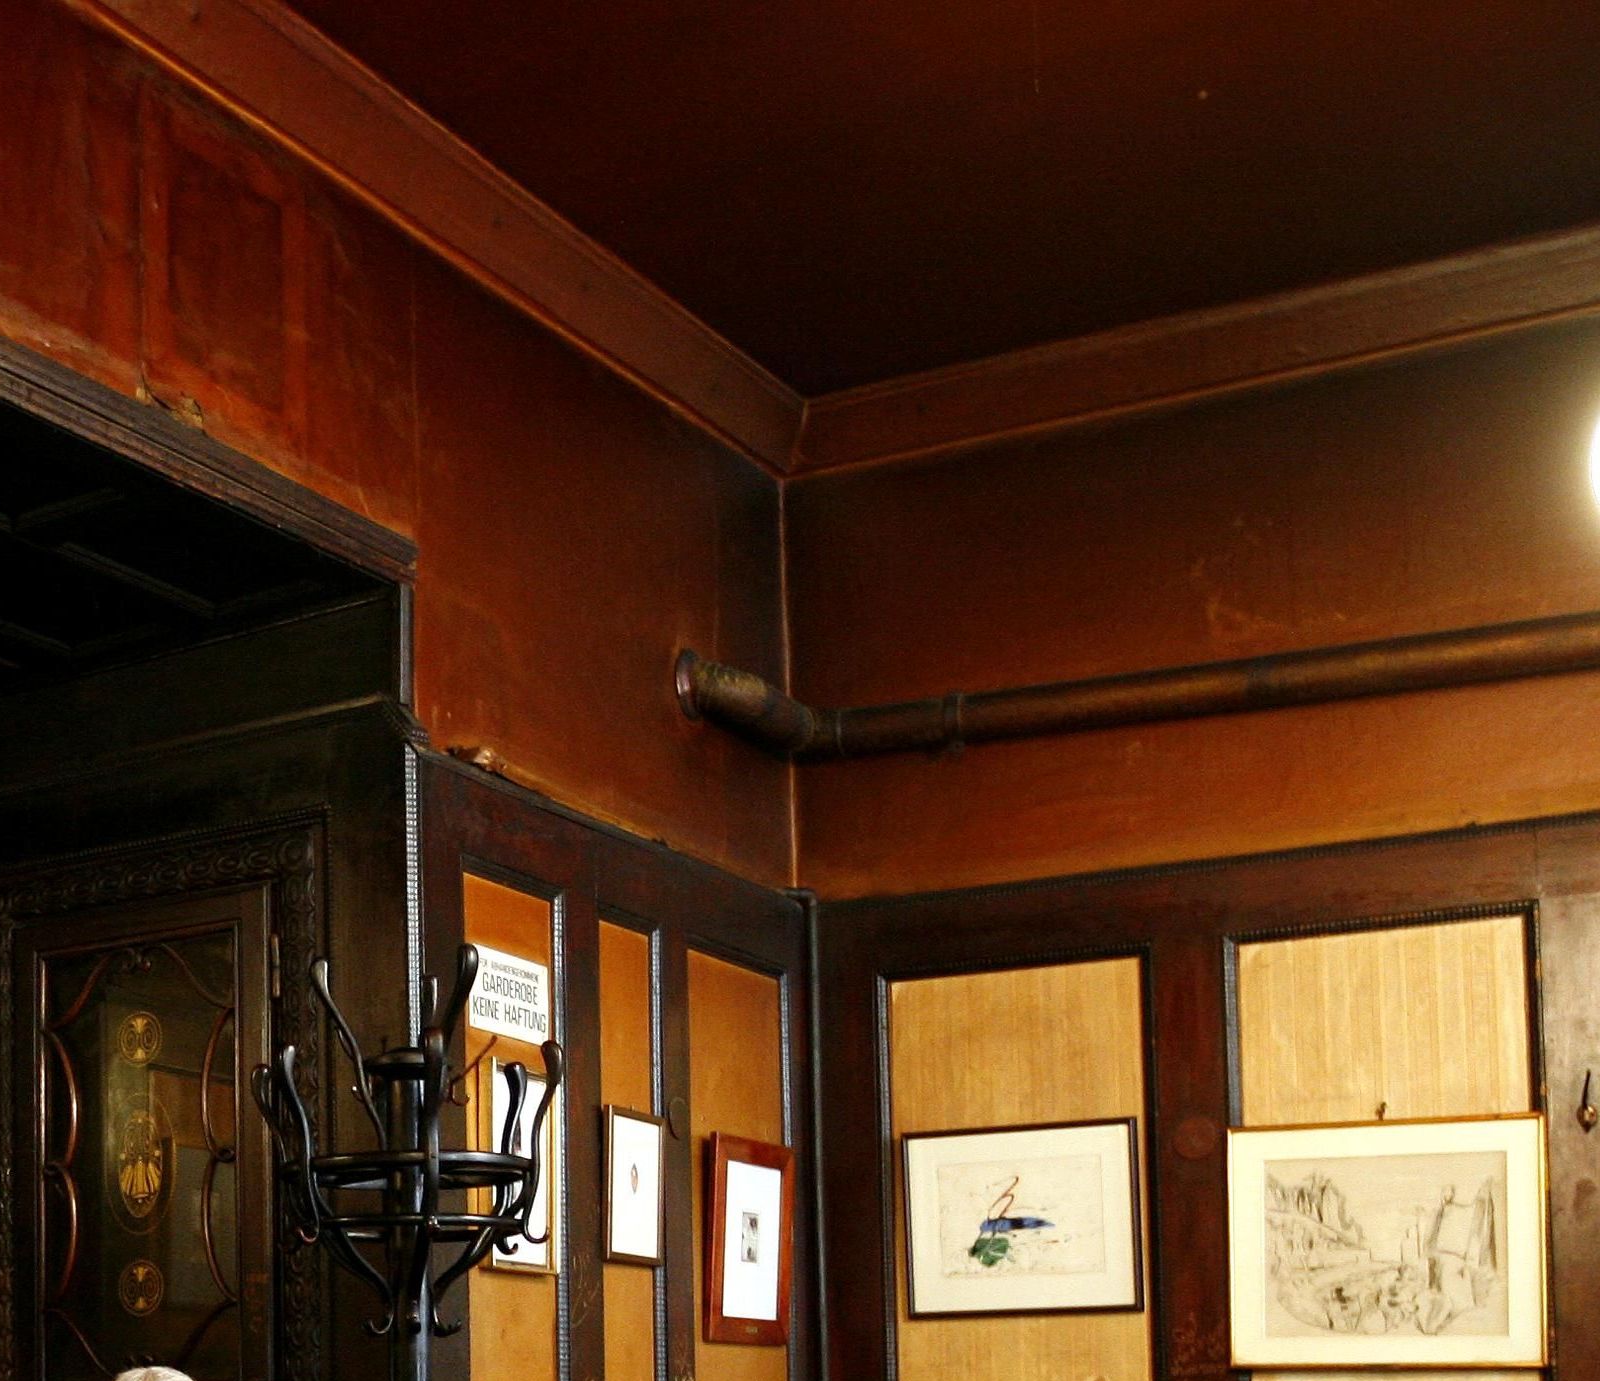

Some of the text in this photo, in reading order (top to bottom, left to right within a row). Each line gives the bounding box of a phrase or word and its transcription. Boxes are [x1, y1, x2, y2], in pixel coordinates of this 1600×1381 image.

[482, 972, 538, 1005] GARDEROBE
[473, 995, 547, 1033] KEINE HAFTUNG
